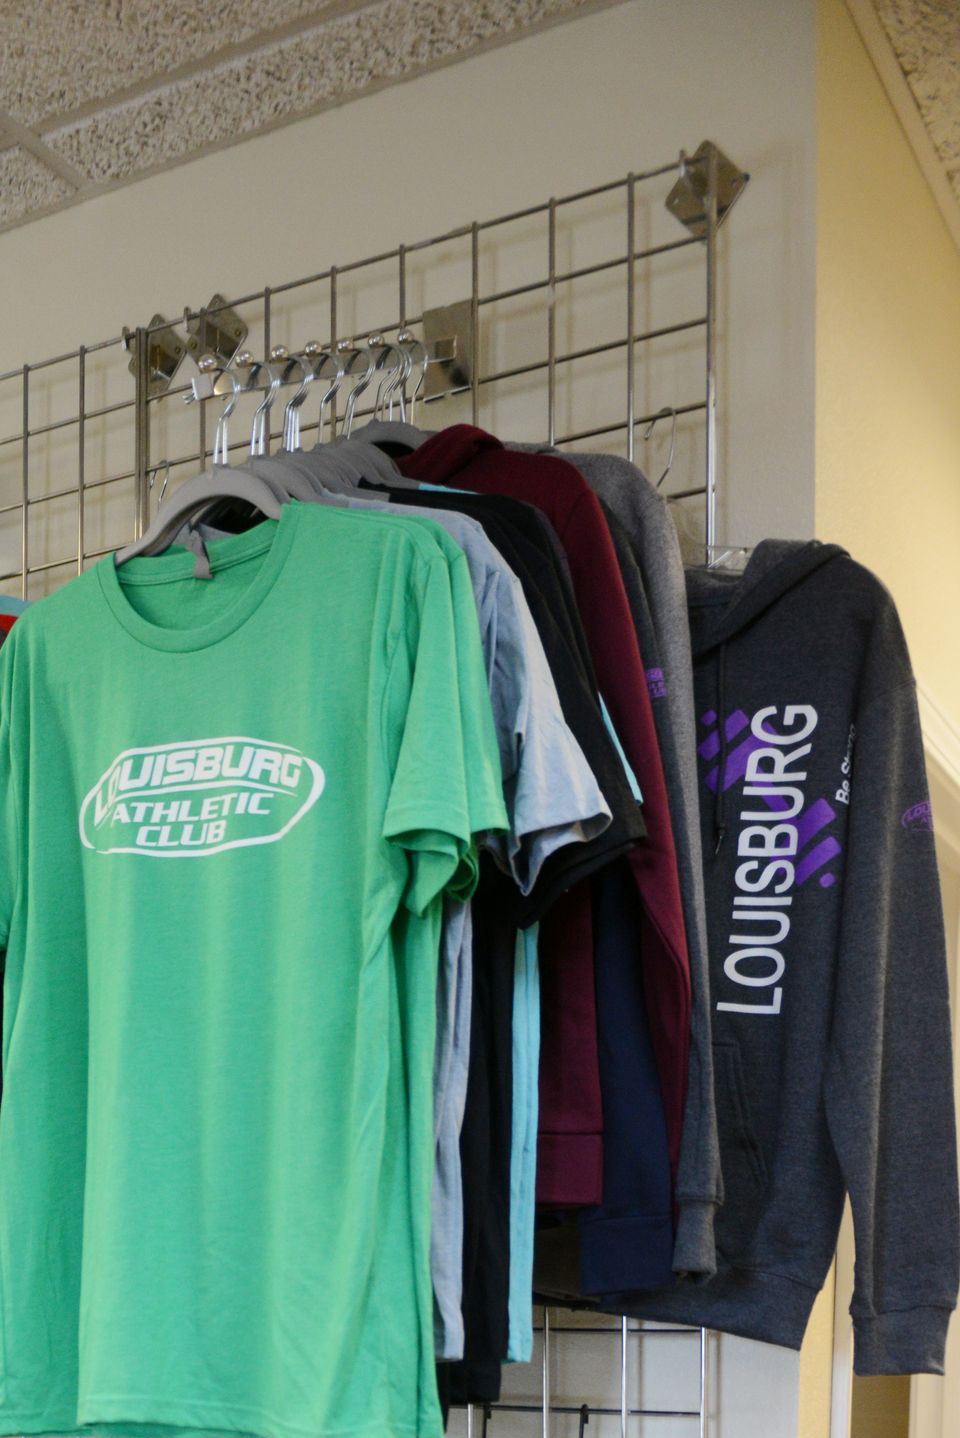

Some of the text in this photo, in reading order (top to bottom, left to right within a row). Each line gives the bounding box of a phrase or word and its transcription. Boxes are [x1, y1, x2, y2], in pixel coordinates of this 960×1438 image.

[111, 793, 274, 829] ATHLETIC
[136, 820, 227, 847] CLUB
[716, 704, 818, 1015] LOUISBURG
